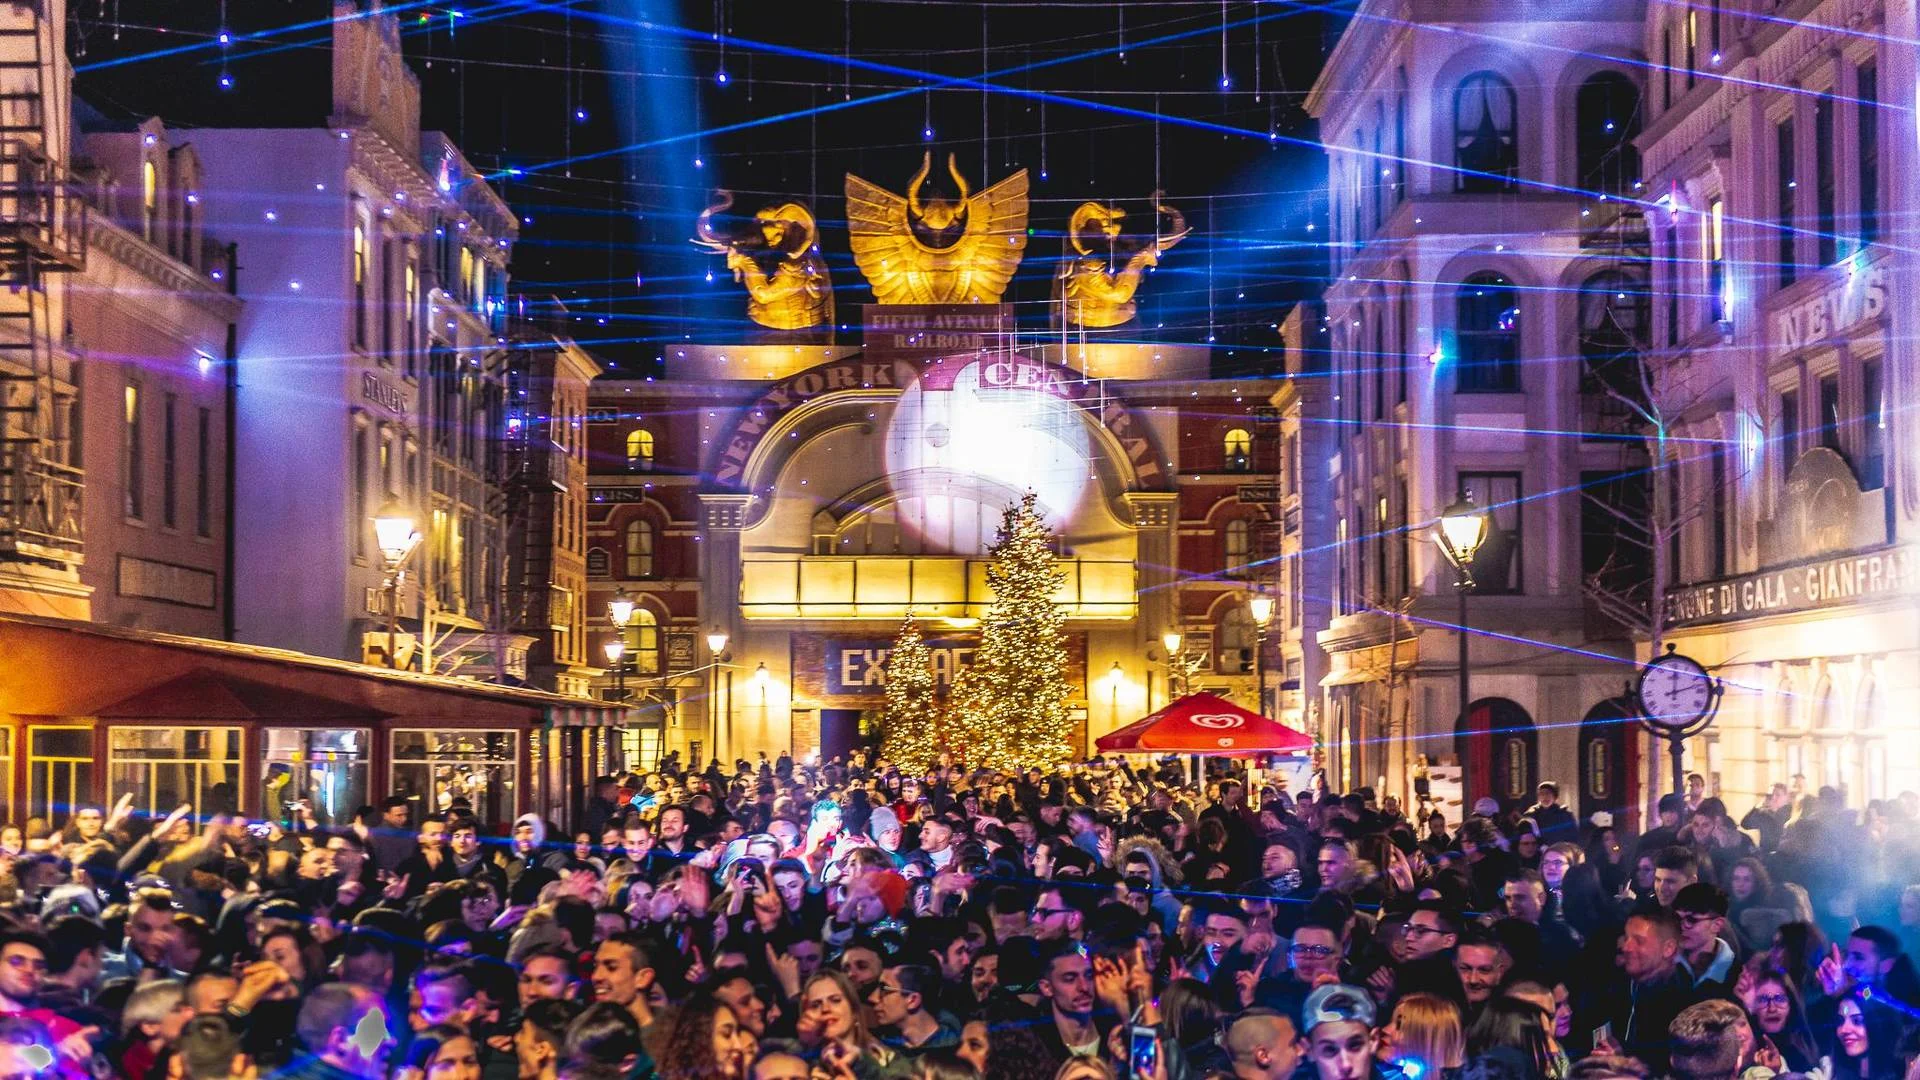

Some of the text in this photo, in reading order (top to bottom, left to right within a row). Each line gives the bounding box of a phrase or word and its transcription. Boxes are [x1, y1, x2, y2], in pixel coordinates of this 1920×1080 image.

[872, 314, 927, 329] FIFTH
[1779, 271, 1886, 354] NEWS
[715, 410, 768, 486] NEW
[765, 364, 893, 410] YORK
[1720, 583, 1737, 615] DI
[1742, 575, 1787, 611] GALA
